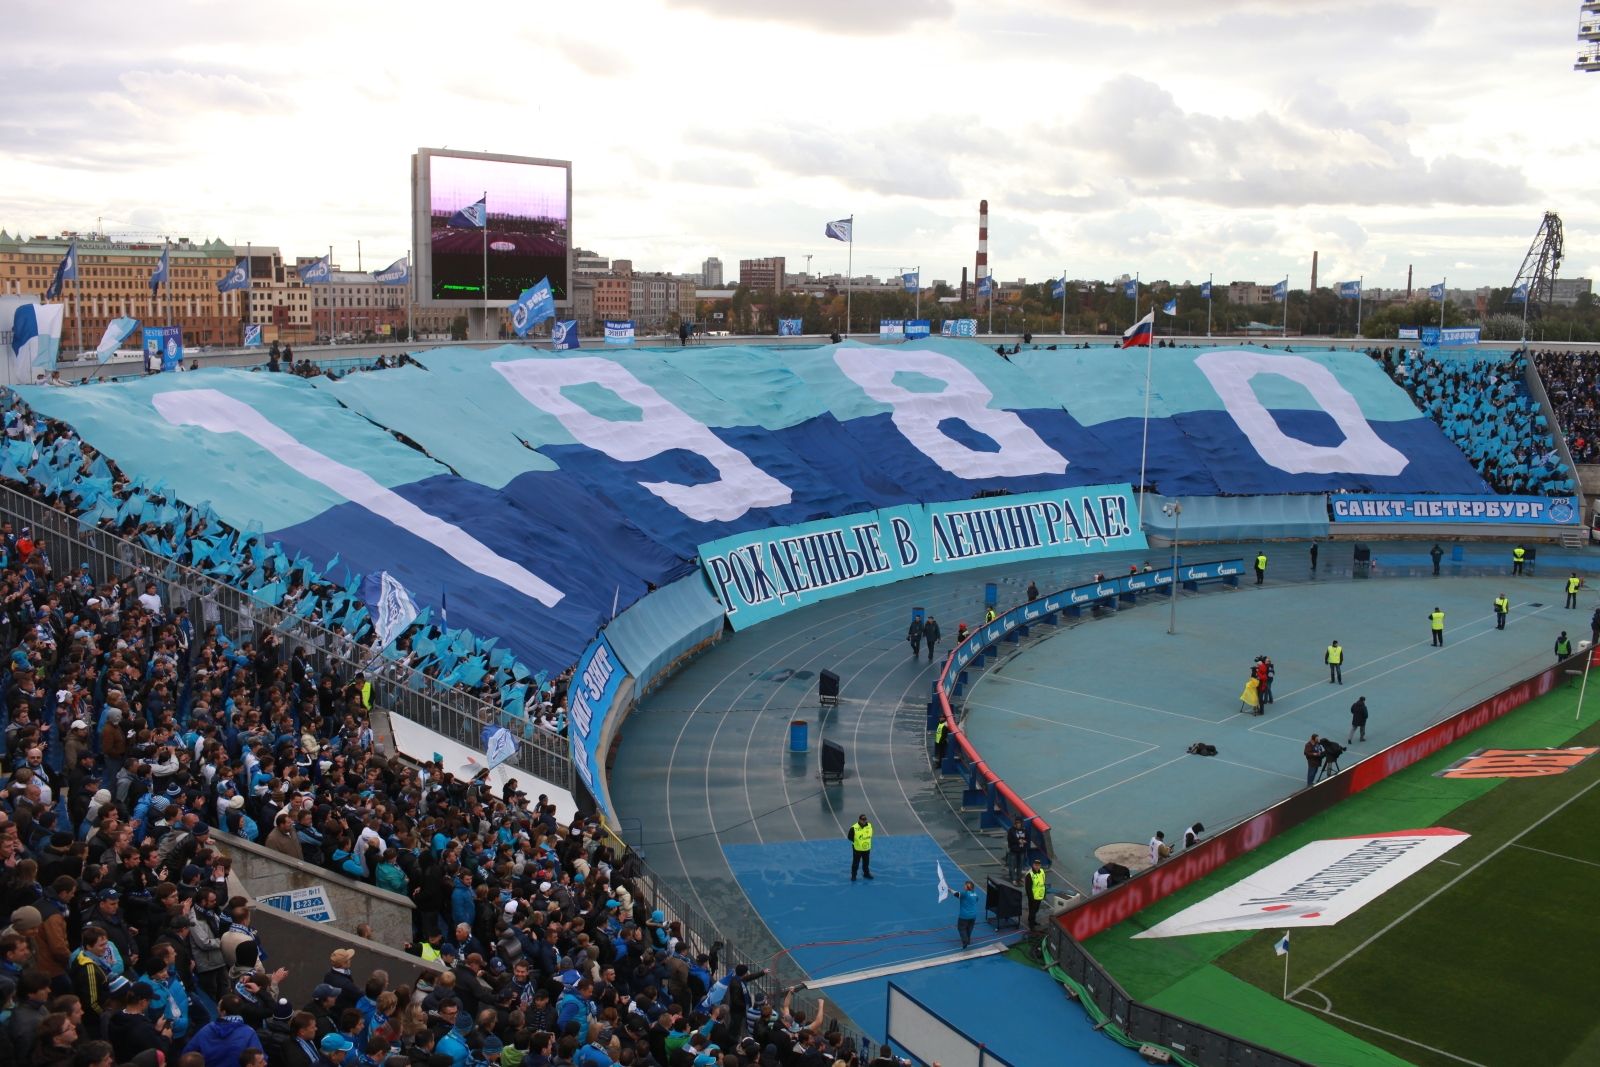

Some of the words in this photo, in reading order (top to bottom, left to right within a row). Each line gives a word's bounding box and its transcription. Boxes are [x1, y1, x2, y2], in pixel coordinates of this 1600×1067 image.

[1334, 500, 1544, 518] САНКТ-ПЕТЕРБУРГ
[708, 522, 891, 615] РОЖДЕННЫЕ
[891, 516, 918, 567] В
[931, 495, 1132, 563] ЛЕНИНГРАДЕ!
[583, 643, 614, 701] ЗЕНИТ
[1386, 723, 1454, 772] Vorsprung
[1457, 704, 1488, 736] durch
[1492, 685, 1530, 713] Technik
[295, 900, 312, 908] 8-23
[1073, 887, 1142, 939] durch
[1150, 840, 1227, 897] Technik
